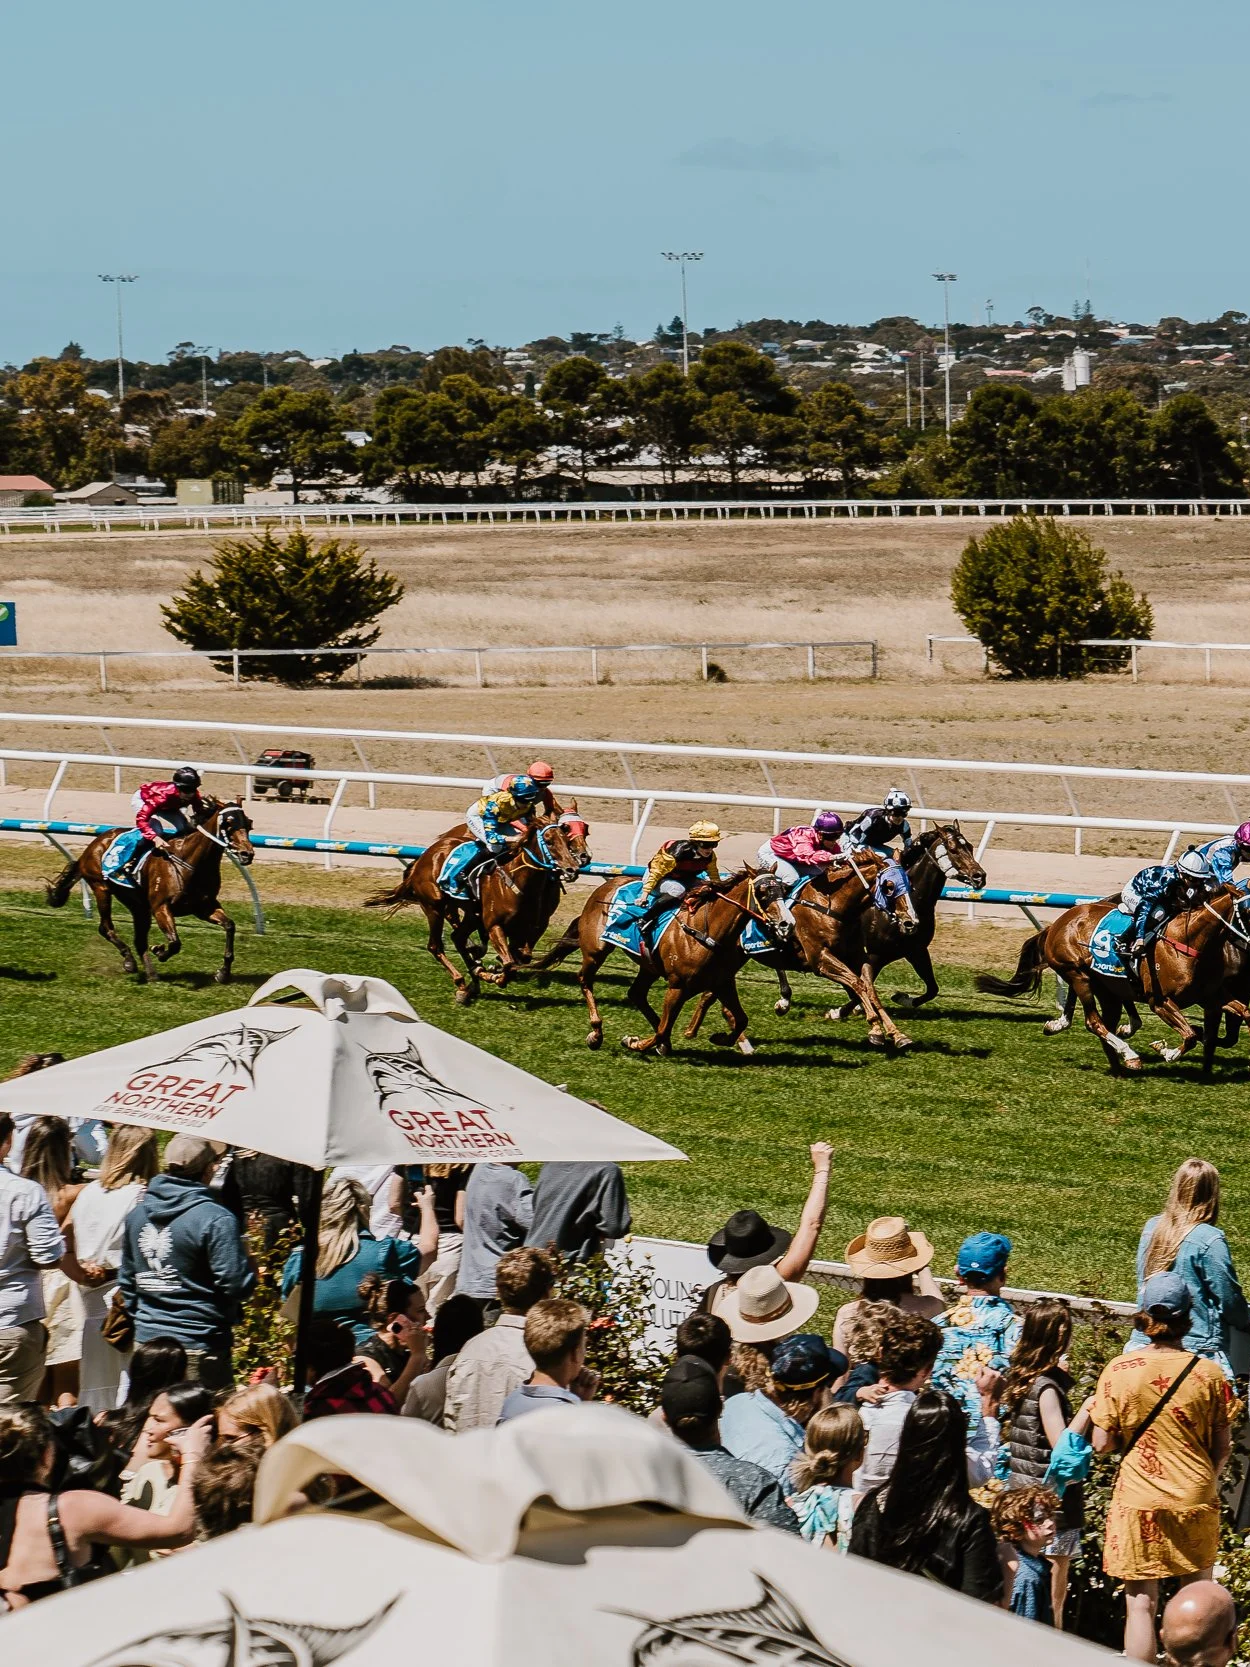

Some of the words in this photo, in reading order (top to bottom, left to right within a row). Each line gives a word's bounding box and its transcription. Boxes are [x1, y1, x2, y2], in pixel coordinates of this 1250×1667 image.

[126, 1072, 248, 1104] GREAT
[103, 1091, 225, 1120] NORTHERN
[388, 1109, 496, 1132] GREAT
[402, 1132, 516, 1149] NORTHERN
